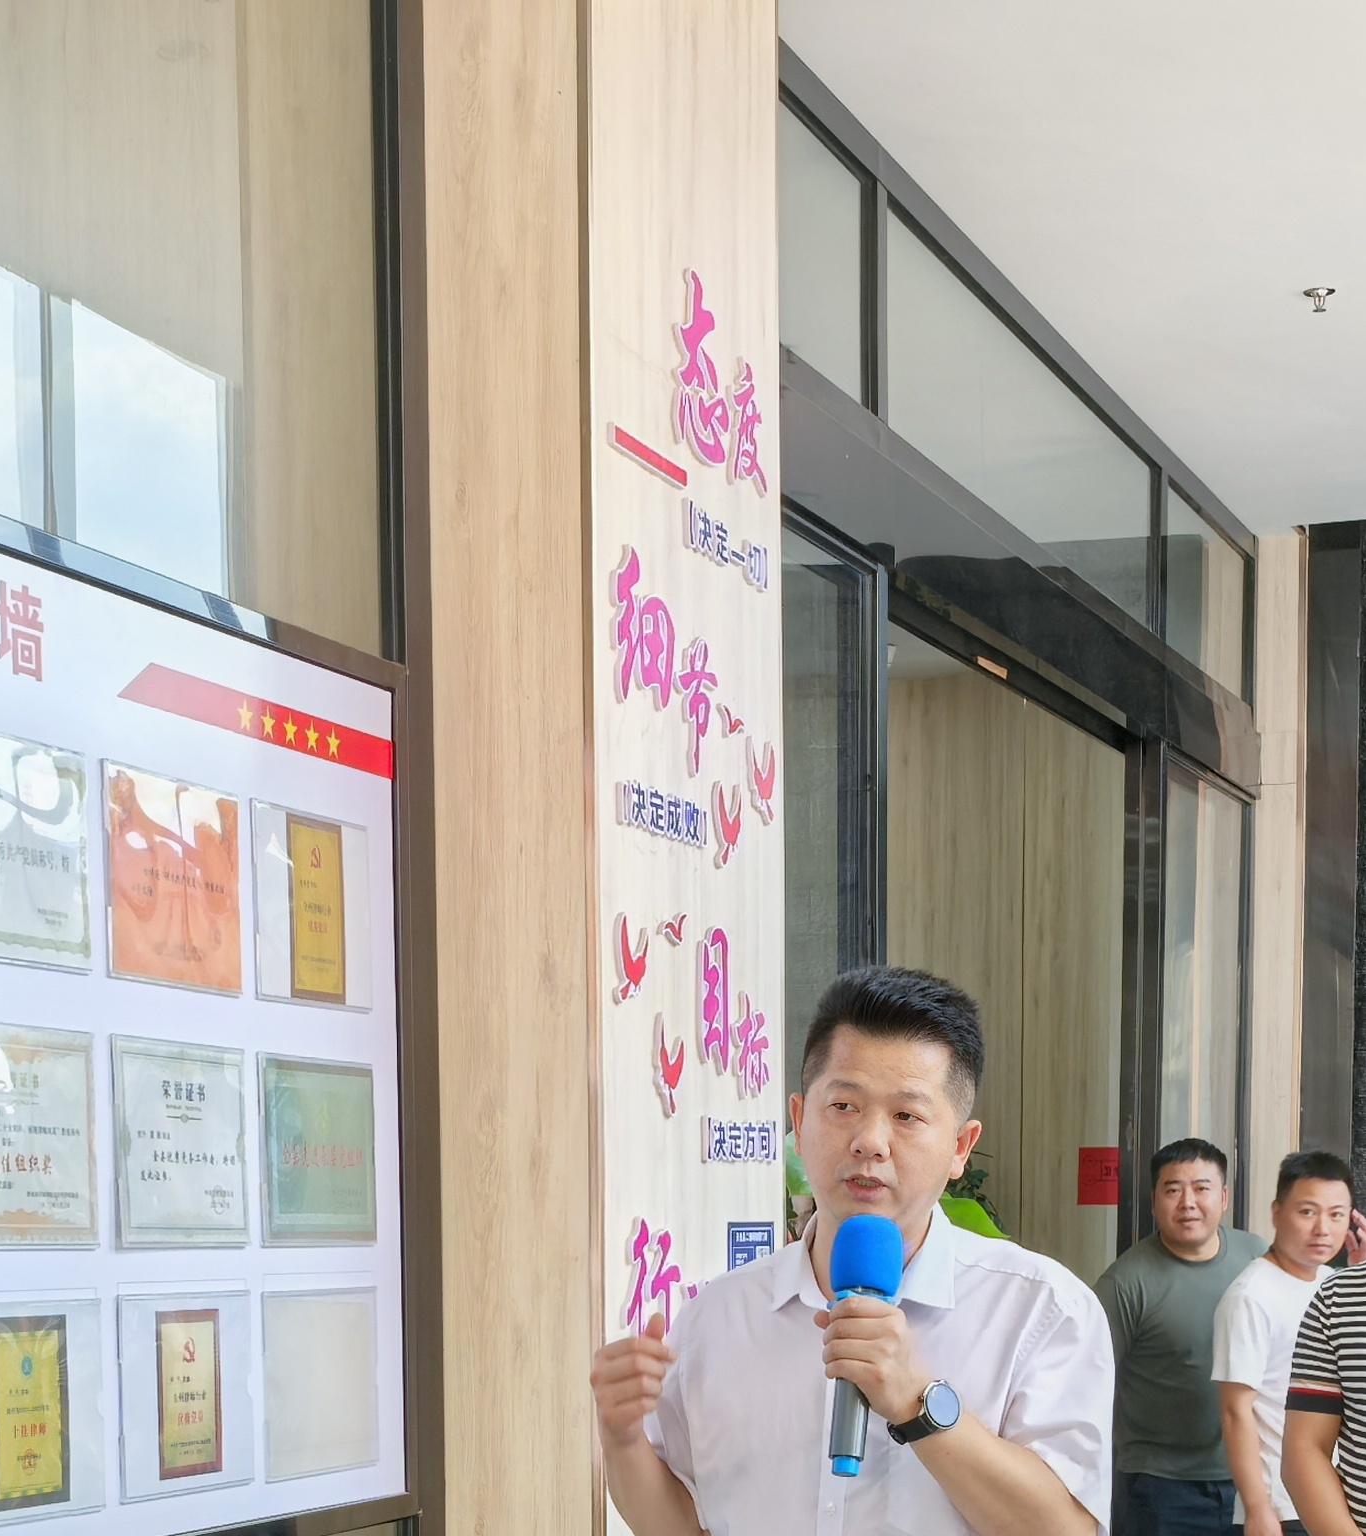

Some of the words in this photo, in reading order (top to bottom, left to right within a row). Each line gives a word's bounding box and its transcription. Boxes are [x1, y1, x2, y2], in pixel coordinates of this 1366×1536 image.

[675, 268, 768, 497] 态度
[613, 545, 718, 777] 细节
[162, 1079, 206, 1102] 荣誉证书
[701, 926, 769, 1098] 目标
[626, 1216, 699, 1339] 行
